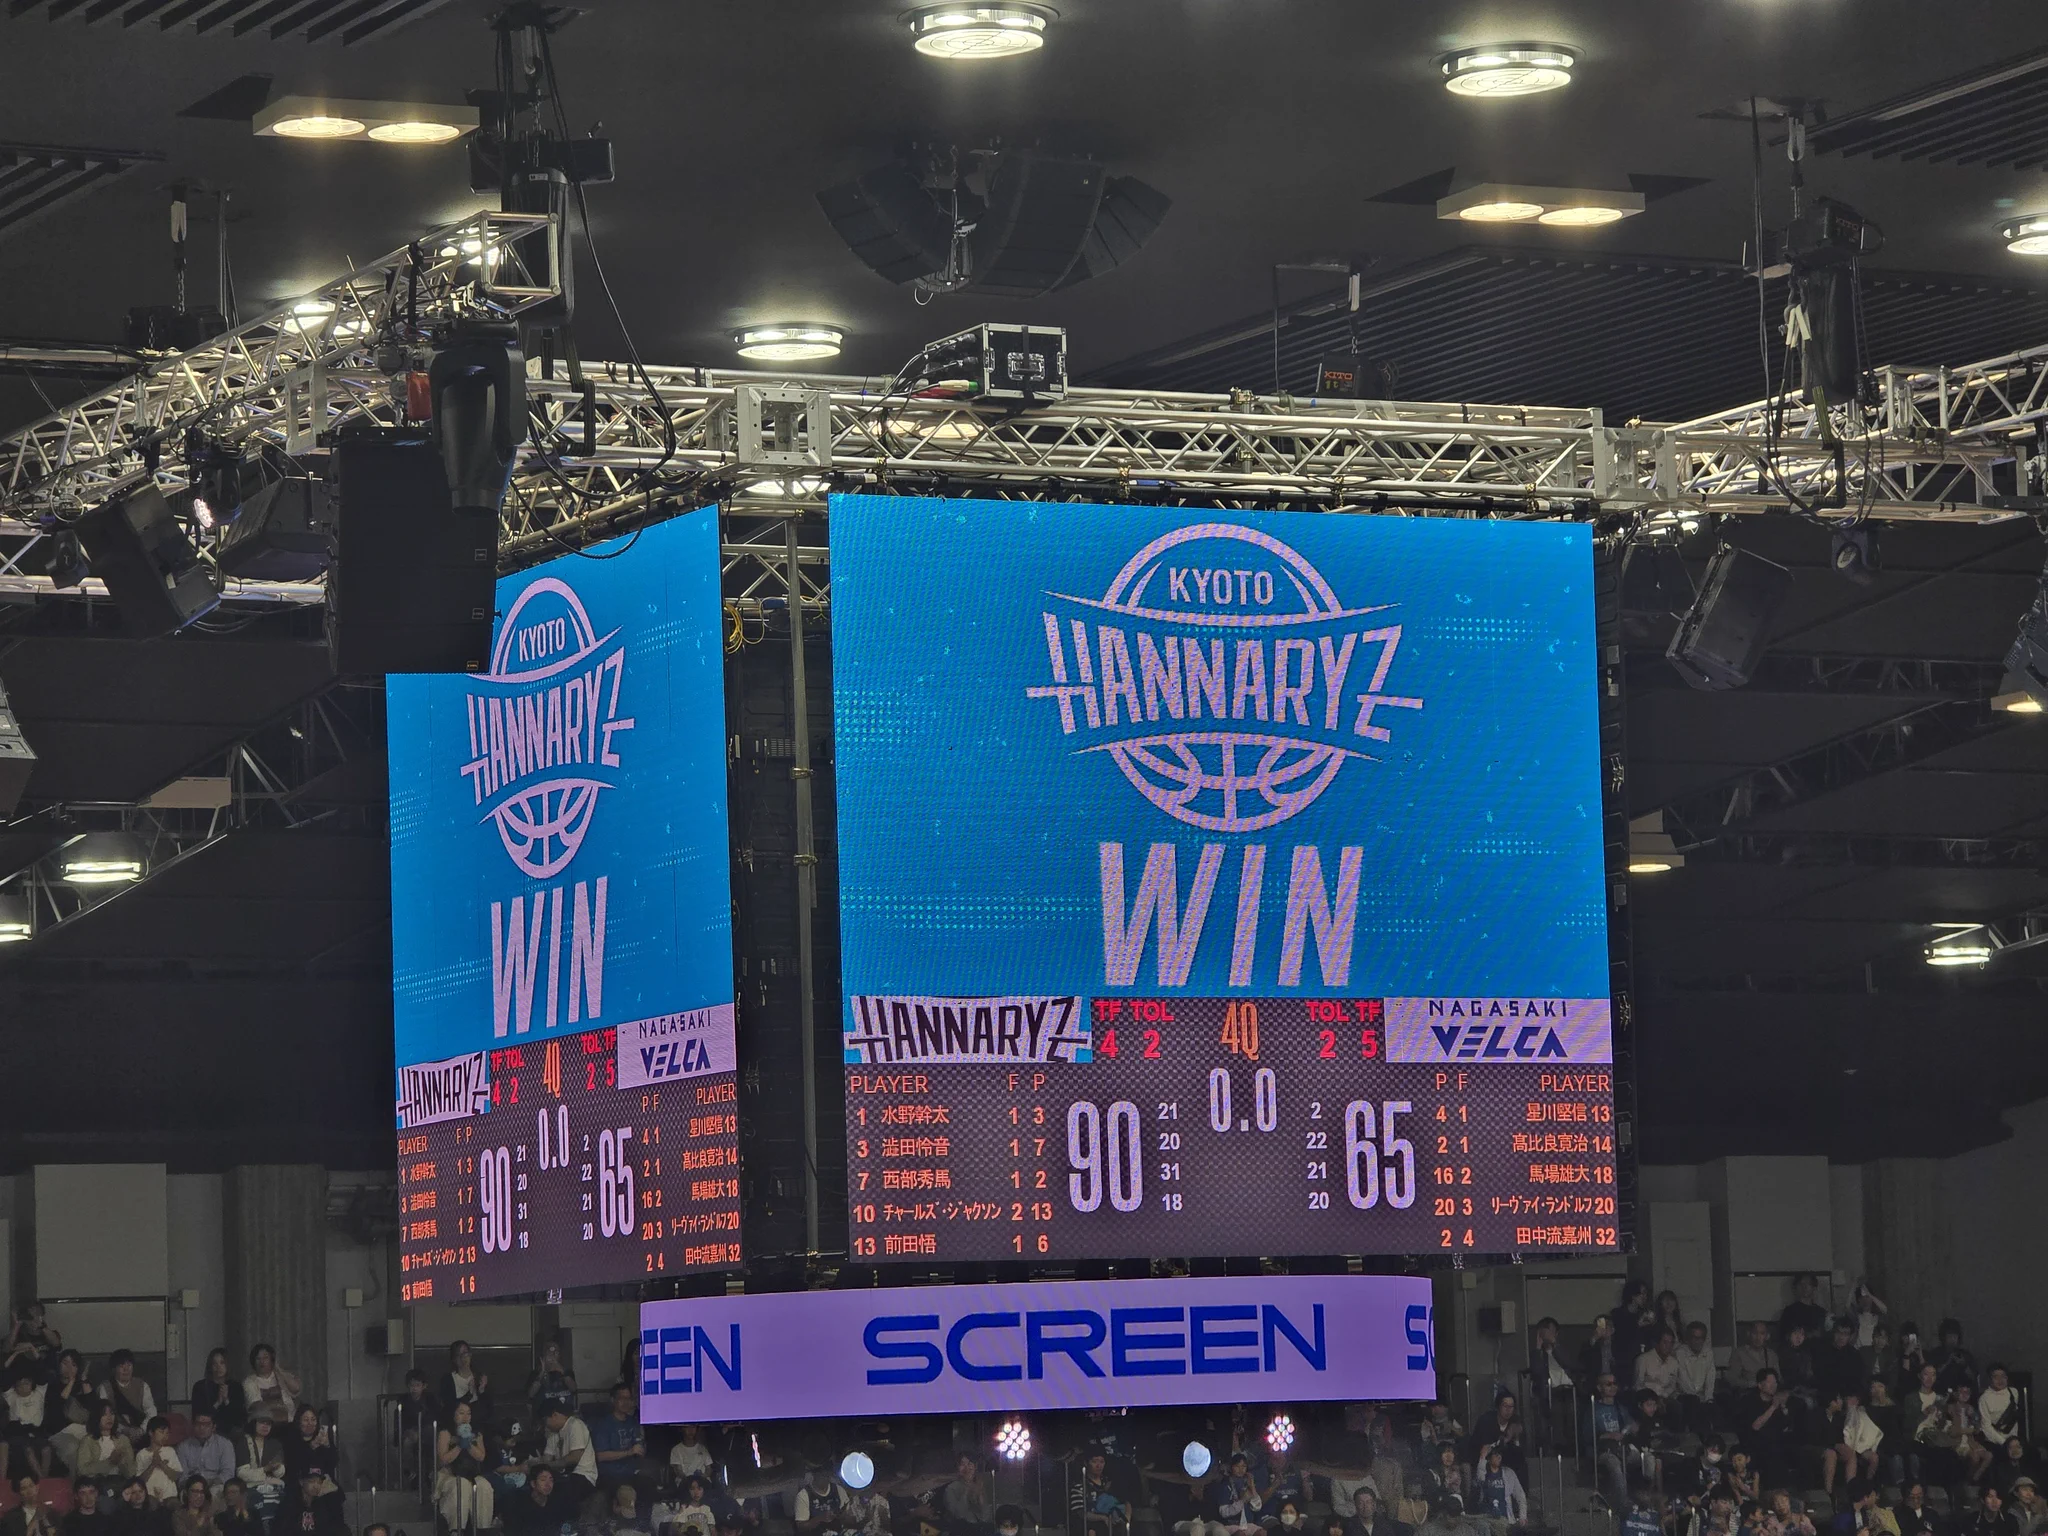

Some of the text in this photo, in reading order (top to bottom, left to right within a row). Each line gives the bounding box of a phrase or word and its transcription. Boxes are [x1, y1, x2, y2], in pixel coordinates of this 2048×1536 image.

[1169, 566, 1273, 605] KYOTO
[518, 616, 566, 662] KYOTO
[1026, 611, 1423, 744] HANNARYZ
[460, 646, 635, 806] HANNARYZ
[1100, 842, 1363, 987] WIN
[491, 876, 608, 1038] WIN
[1096, 1001, 1174, 1021] TF TOL
[1307, 1002, 1380, 1022] TOL TF
[1429, 1000, 1568, 1017] NAGASAKI
[639, 1010, 711, 1039] NAGASAKI
[849, 996, 1088, 1063] HANNARYZ
[1221, 1002, 1259, 1060] 4Q
[581, 1030, 617, 1054] TOL TF
[1100, 1030, 1161, 1058] 4 2
[1319, 1030, 1377, 1058] 2 5
[1430, 1026, 1568, 1058] VELCA
[491, 1049, 525, 1072] TF TOL
[543, 1042, 560, 1098] 4Q
[640, 1038, 712, 1079] VELCA
[586, 1058, 615, 1090] 2 5
[850, 1073, 1045, 1094] PLAYER F P
[1436, 1073, 1610, 1092] P F PLAYER
[398, 1052, 488, 1128] HANNARYZ
[493, 1077, 519, 1106] 4 2
[642, 1083, 736, 1112] P F PLAYER
[1209, 1068, 1277, 1132] 0.0
[857, 1109, 867, 1126] 1
[1009, 1107, 1018, 1125] 1
[1033, 1107, 1045, 1125] 3
[1158, 1103, 1178, 1119] 21
[1311, 1102, 1322, 1119] 2
[1436, 1106, 1447, 1122] 4
[1459, 1106, 1467, 1122] 1
[1591, 1106, 1611, 1122] 13
[399, 1127, 472, 1156] PLAYER F P
[538, 1105, 570, 1170] 0.0
[583, 1134, 590, 1151] 2
[642, 1128, 650, 1145] 4
[654, 1126, 660, 1144] 1
[725, 1115, 736, 1133] 13
[1159, 1133, 1180, 1150] 20
[1306, 1132, 1327, 1149] 22
[516, 1144, 527, 1163] 21
[857, 1141, 869, 1158] 3
[1010, 1139, 1019, 1157] 1
[1034, 1139, 1046, 1156] 7
[1067, 1101, 1143, 1212] 90
[1345, 1100, 1416, 1209] 65
[1438, 1137, 1448, 1153] 2
[1460, 1137, 1469, 1153] 1
[1592, 1136, 1612, 1153] 14
[401, 1169, 406, 1185] 1
[457, 1159, 462, 1176] 1
[466, 1157, 473, 1174] 3
[581, 1163, 593, 1182] 22
[643, 1159, 650, 1178] 2
[655, 1158, 661, 1176] 1
[725, 1147, 738, 1166] 14
[1161, 1163, 1180, 1180] 31
[1307, 1162, 1327, 1179] 21
[1434, 1164, 1613, 1184] 16 2 馬場雄大 18
[517, 1173, 528, 1192] 20
[599, 1126, 635, 1238] 65
[858, 1169, 1047, 1191] 7 西部秀馬 1 2
[401, 1197, 407, 1214] 3
[457, 1188, 463, 1206] 1
[467, 1186, 473, 1204] 7
[480, 1146, 512, 1254] 90
[582, 1193, 593, 1211] 21
[642, 1190, 652, 1209] 16
[655, 1189, 662, 1207] 2
[726, 1179, 738, 1199] 18
[1162, 1193, 1182, 1211] 18
[1308, 1192, 1329, 1210] 20
[1435, 1199, 1454, 1216] 20
[1463, 1199, 1473, 1215] 3
[1595, 1198, 1614, 1215] 20
[518, 1203, 528, 1221] 31
[854, 1205, 874, 1223] 10
[1011, 1203, 1023, 1221] 2
[1031, 1203, 1053, 1221] 13
[402, 1226, 408, 1243] 7
[458, 1217, 464, 1235] 1
[468, 1216, 474, 1234] 2
[582, 1222, 594, 1241] 20
[642, 1220, 654, 1241] 20
[656, 1220, 663, 1239] 3
[727, 1211, 739, 1230] 20
[1441, 1230, 1451, 1247] 2
[1463, 1229, 1474, 1246] 4
[1596, 1228, 1616, 1245] 32
[518, 1232, 529, 1250] 18
[855, 1234, 1049, 1255] 13 前田悟 1 6
[401, 1253, 411, 1272] 10
[459, 1247, 465, 1265] 2
[467, 1246, 476, 1265] 13
[646, 1253, 654, 1272] 2
[657, 1252, 665, 1271] 4
[728, 1243, 741, 1262] 32
[402, 1284, 411, 1301] 13
[460, 1276, 465, 1294] 1
[469, 1275, 476, 1293] 6
[863, 1303, 1327, 1385] SCREEN
[1405, 1305, 1435, 1371] S
[640, 1323, 741, 1395] EEN
